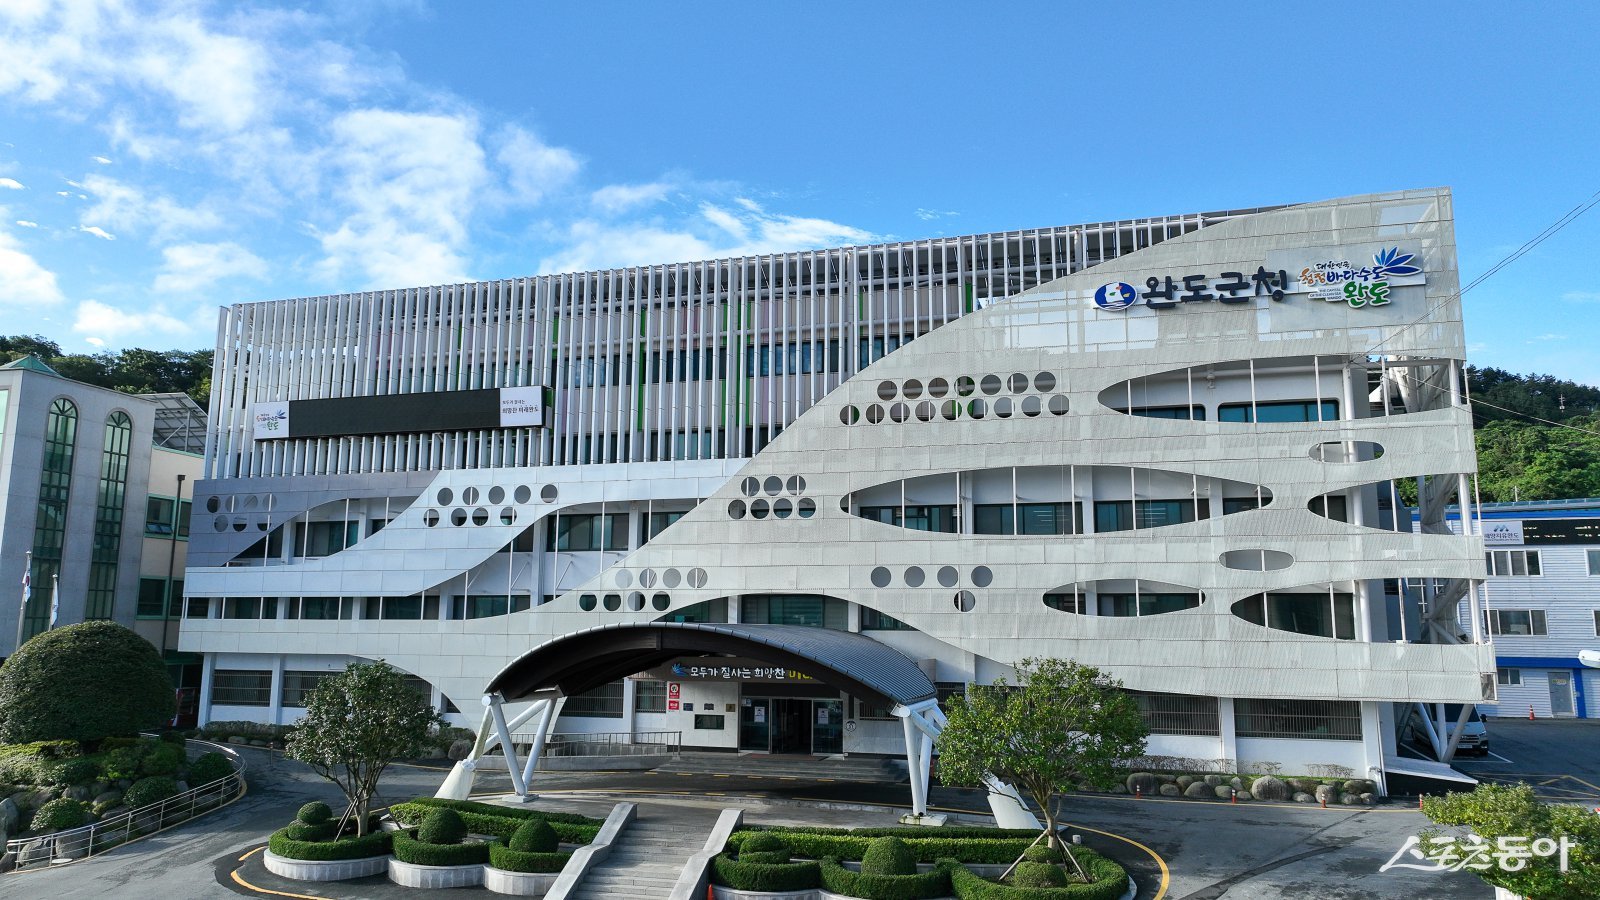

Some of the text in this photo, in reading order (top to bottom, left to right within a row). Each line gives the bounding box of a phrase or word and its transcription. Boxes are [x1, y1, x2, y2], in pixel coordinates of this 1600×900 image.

[1316, 261, 1350, 270] 대한민국
[1142, 266, 1287, 308] 완도군청
[1343, 281, 1388, 306] 완도
[690, 667, 718, 677] 모두가
[754, 667, 785, 679] 희망찬
[789, 670, 813, 680] 미
